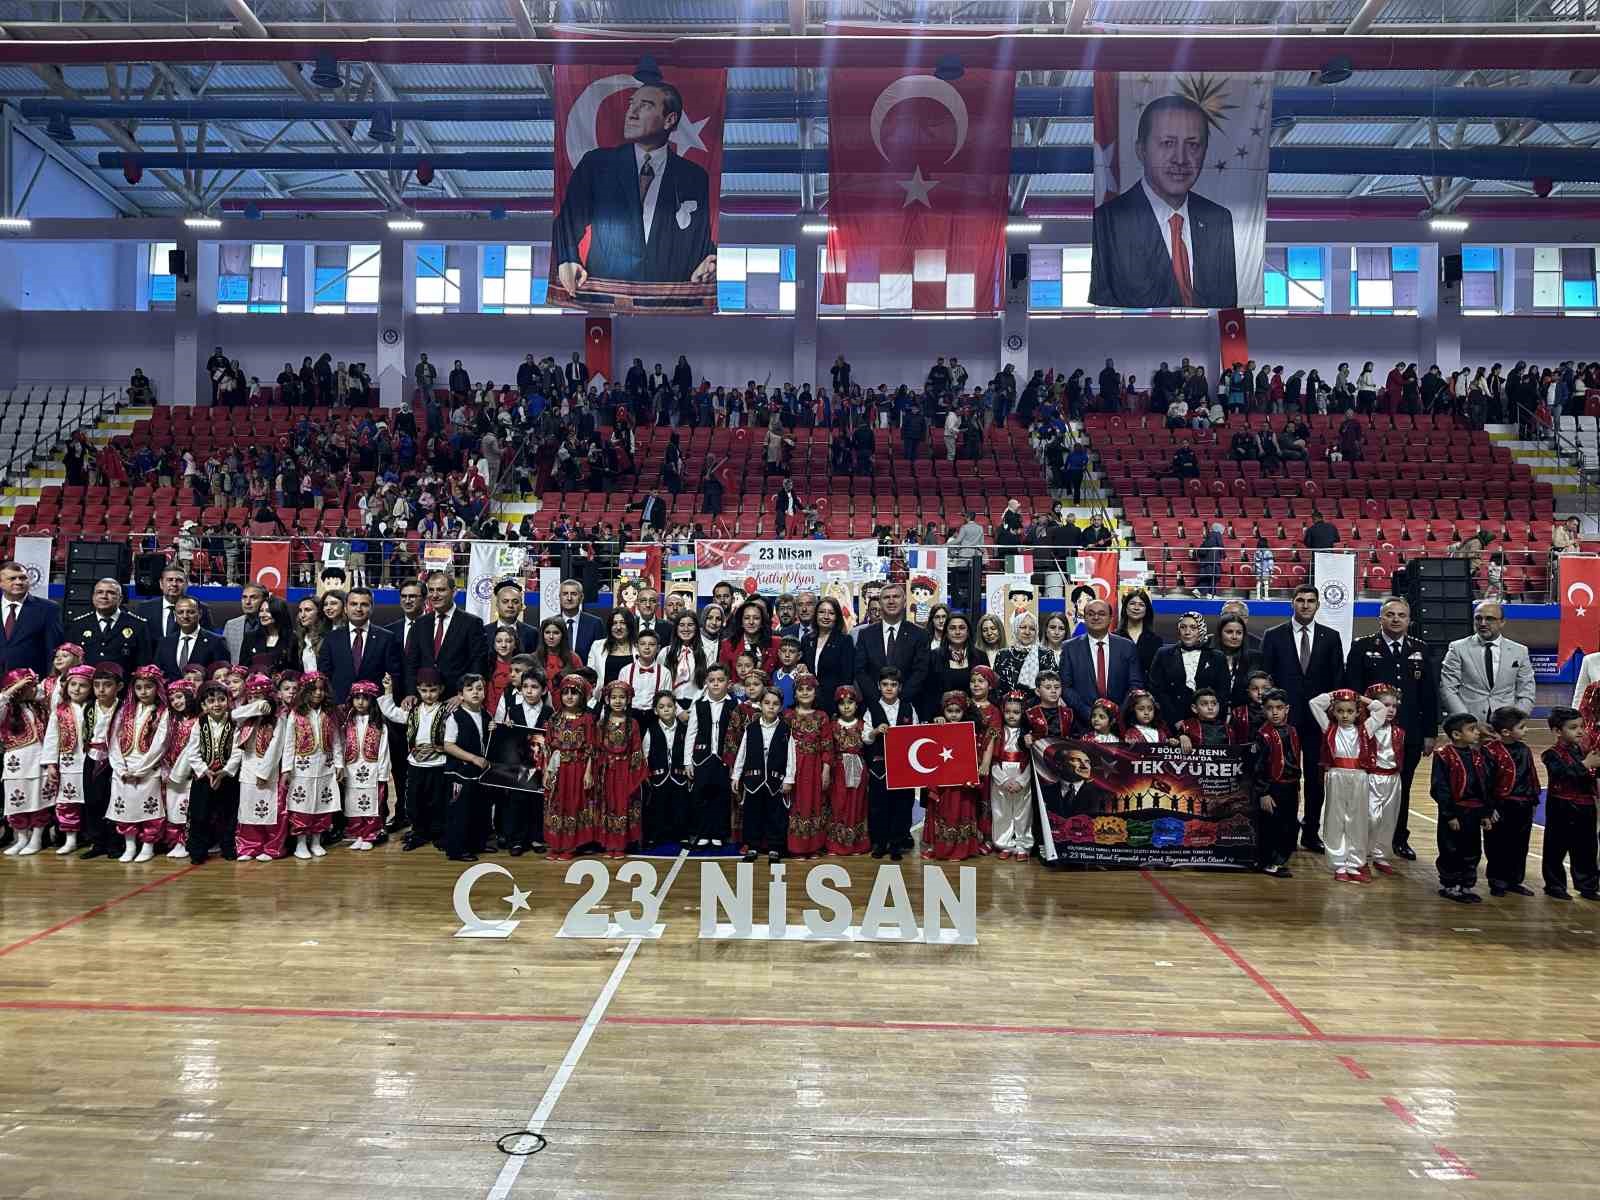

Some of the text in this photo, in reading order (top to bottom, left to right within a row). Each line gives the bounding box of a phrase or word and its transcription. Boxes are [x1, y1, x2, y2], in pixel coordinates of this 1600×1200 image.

[759, 547, 812, 560] 23 Nisan
[1157, 745, 1182, 754] BÖLG
[1131, 760, 1244, 777] TEK YÜREK
[564, 860, 658, 938] 23
